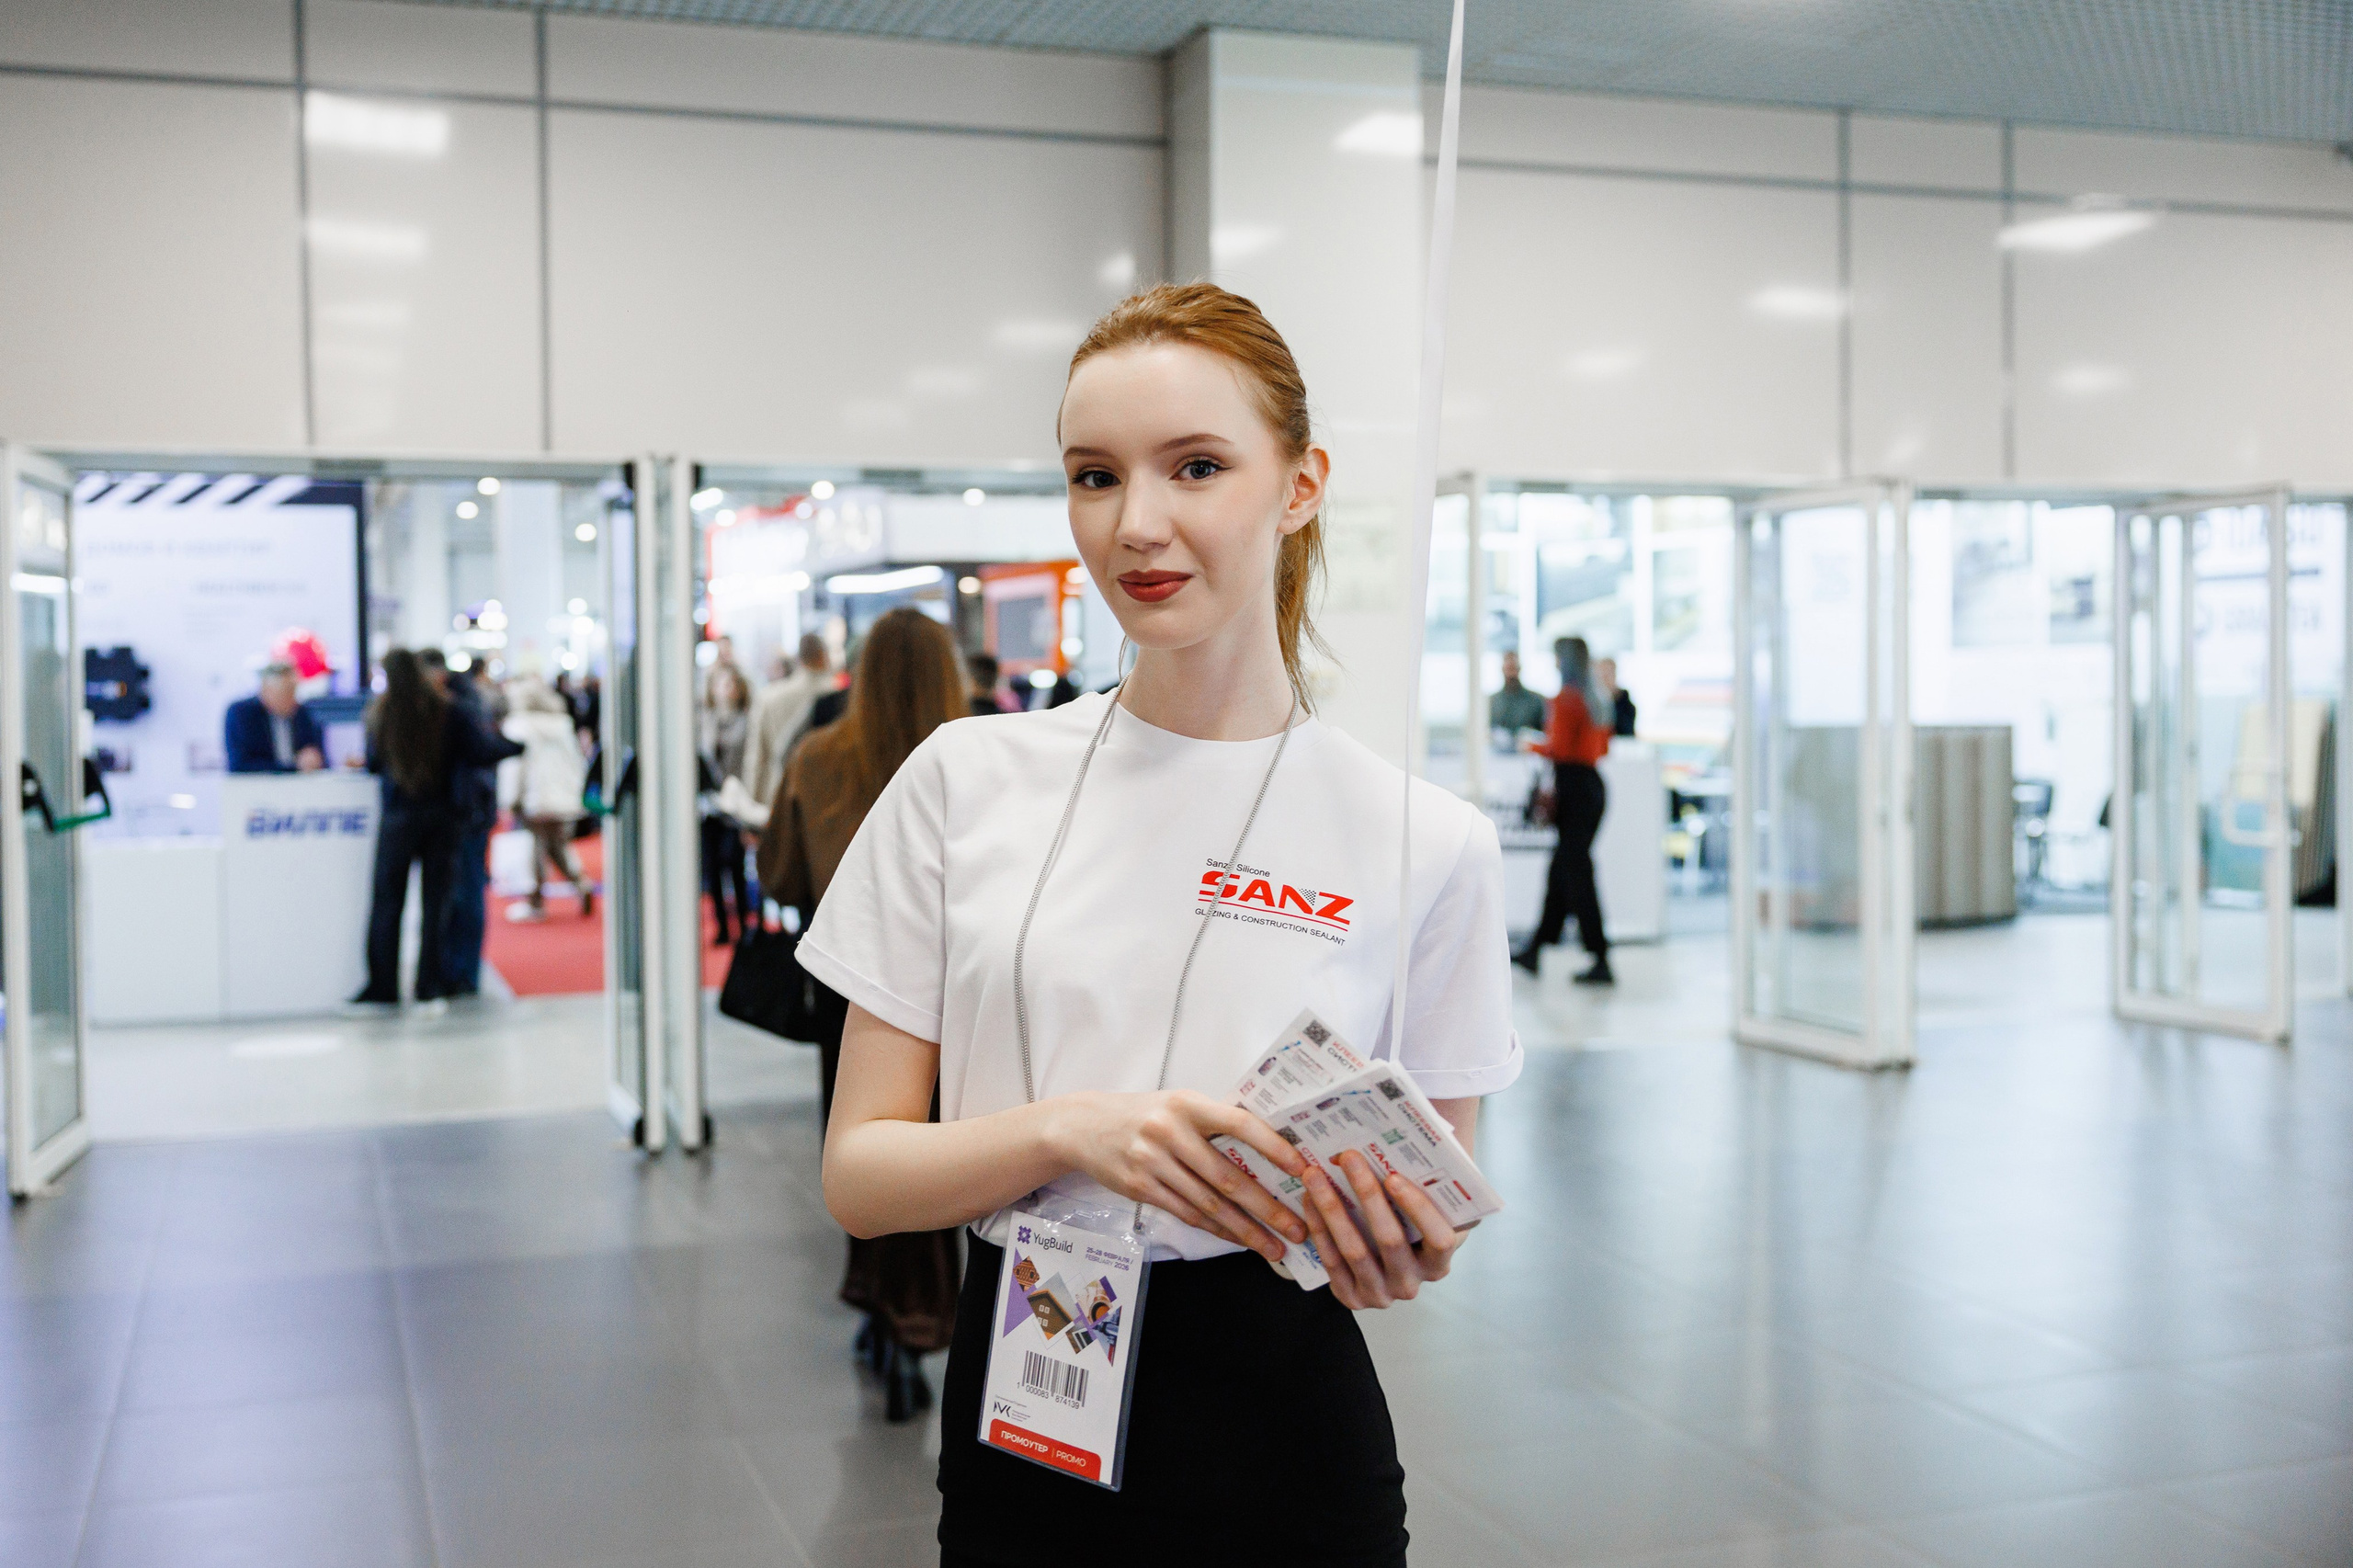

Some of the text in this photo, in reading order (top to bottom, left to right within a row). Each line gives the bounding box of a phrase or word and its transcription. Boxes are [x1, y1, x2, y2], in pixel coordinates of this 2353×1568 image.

[1206, 858, 1270, 877] Sanz Silicone
[1199, 870, 1354, 926] SANZ
[1195, 908, 1232, 919] GLZING
[1241, 915, 1308, 934] CONSTRUCTION
[1310, 928, 1346, 947] SEALANT
[1033, 1233, 1074, 1254] YugBuild
[1086, 1254, 1113, 1266] FEBRUARY
[1054, 1394, 1080, 1410] 874139
[1001, 1430, 1087, 1468] ПРОМОУТЕР PROMO
